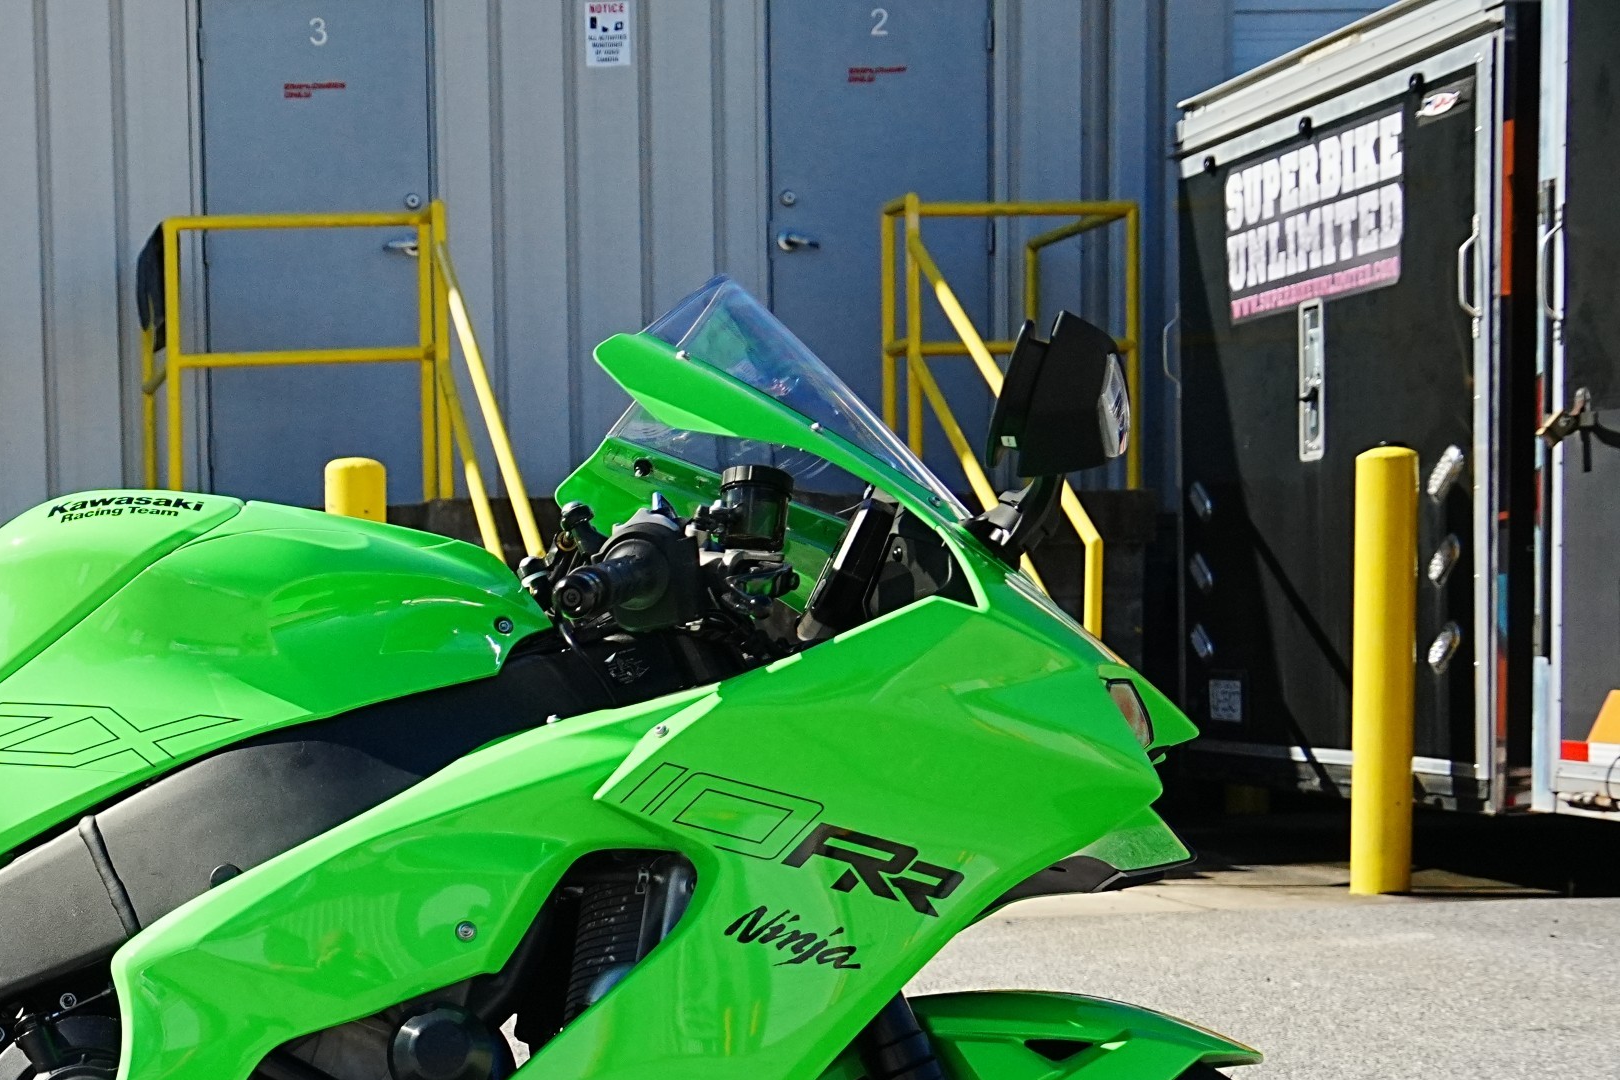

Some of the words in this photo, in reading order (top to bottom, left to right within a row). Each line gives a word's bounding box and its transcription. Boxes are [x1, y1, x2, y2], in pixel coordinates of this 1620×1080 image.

[309, 17, 327, 46] 3
[871, 8, 888, 35] 2
[1225, 110, 1403, 231] SUPERBIKE
[1227, 182, 1404, 292] UNLIMITED
[47, 496, 204, 518] Kawasaki
[60, 507, 123, 523] Racing
[130, 506, 179, 517] Team
[724, 905, 861, 969] Ninja
